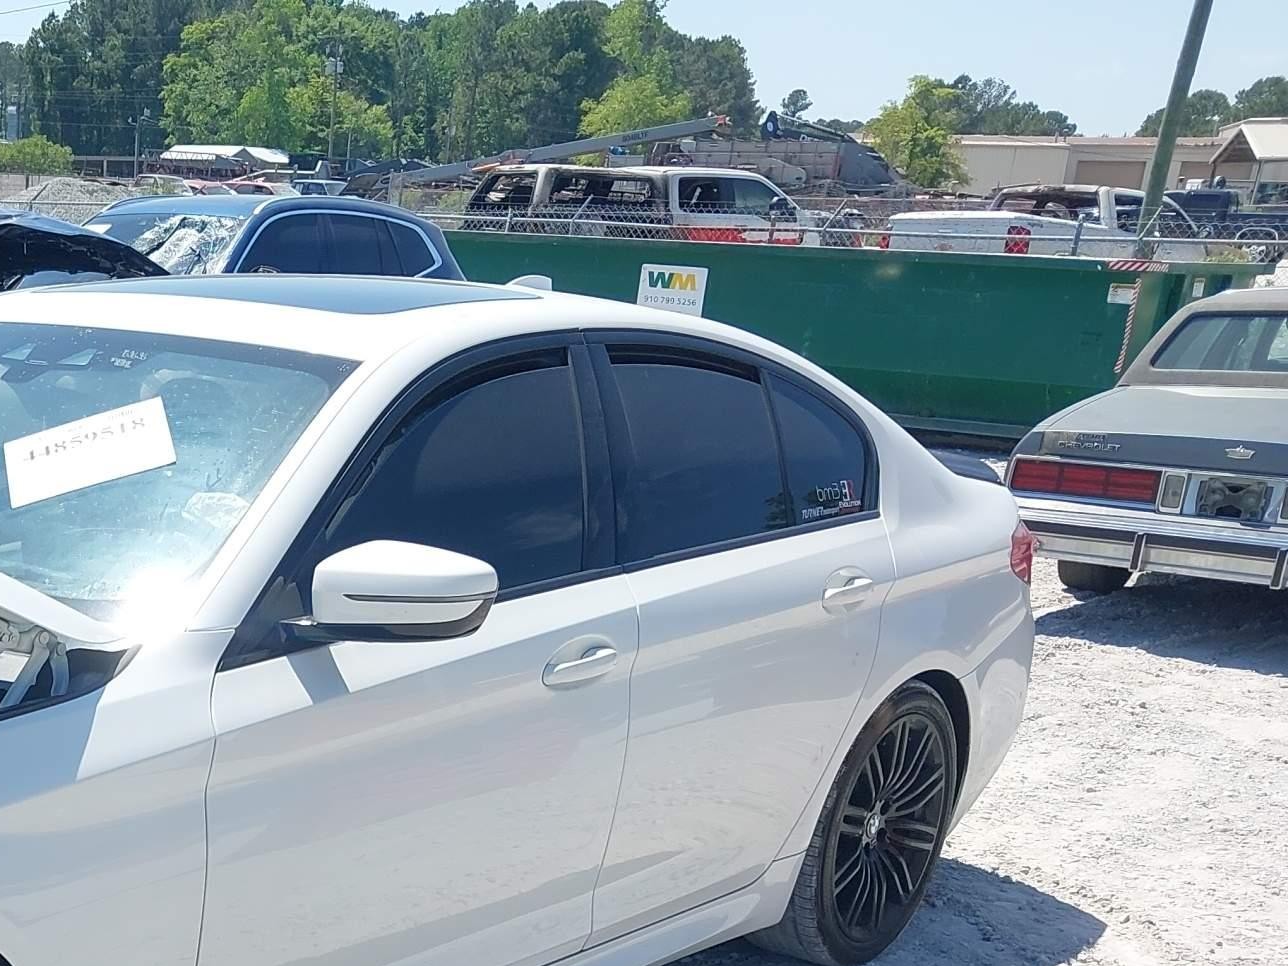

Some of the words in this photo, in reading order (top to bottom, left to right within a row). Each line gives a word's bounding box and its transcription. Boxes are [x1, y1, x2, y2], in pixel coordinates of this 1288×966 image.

[648, 270, 697, 291] WM
[644, 295, 659, 303] 910
[677, 298, 697, 306] 5256
[23, 417, 146, 462] 44859518
[1057, 440, 1121, 453] CHEVROLET
